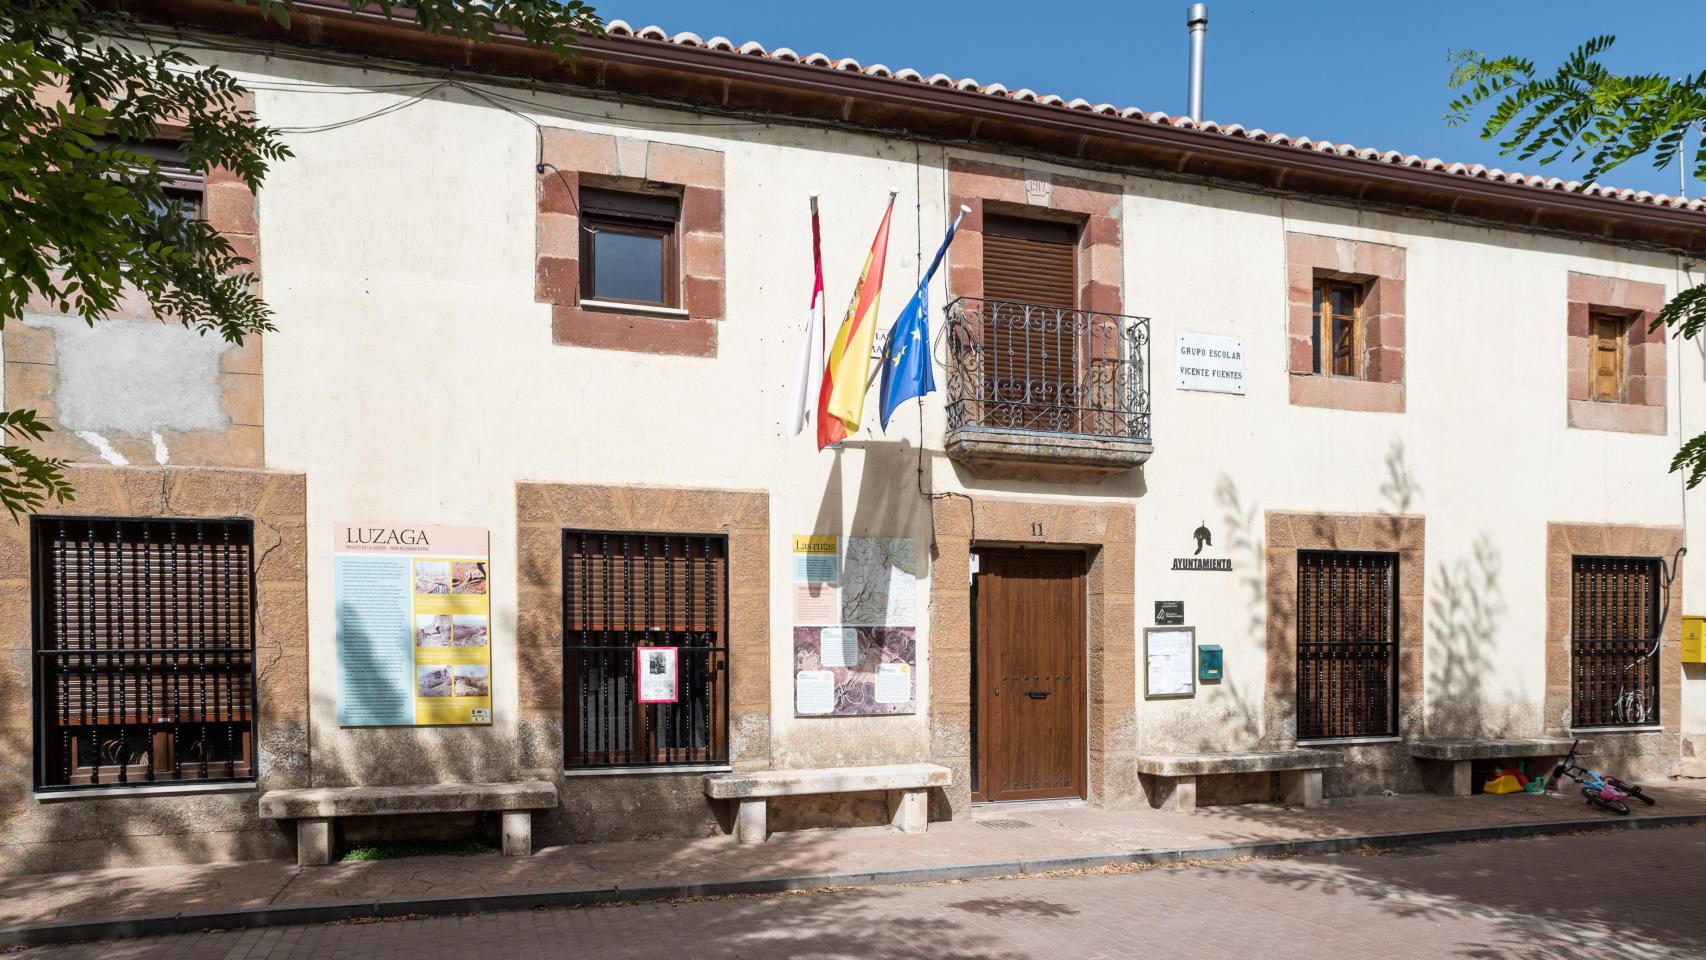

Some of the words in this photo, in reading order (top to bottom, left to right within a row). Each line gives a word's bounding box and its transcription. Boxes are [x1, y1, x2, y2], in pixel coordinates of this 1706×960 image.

[1180, 346, 1206, 357] GRUPO
[1209, 349, 1241, 360] ESCOLAR
[1180, 366, 1210, 377] VICENTE
[1212, 369, 1243, 380] FUENTES
[346, 527, 431, 545] LUZAGA
[1030, 522, 1045, 537] 11
[796, 540, 812, 551] Las
[813, 541, 836, 551] rutas
[1172, 558, 1232, 570] AYUNTAMIENTO
